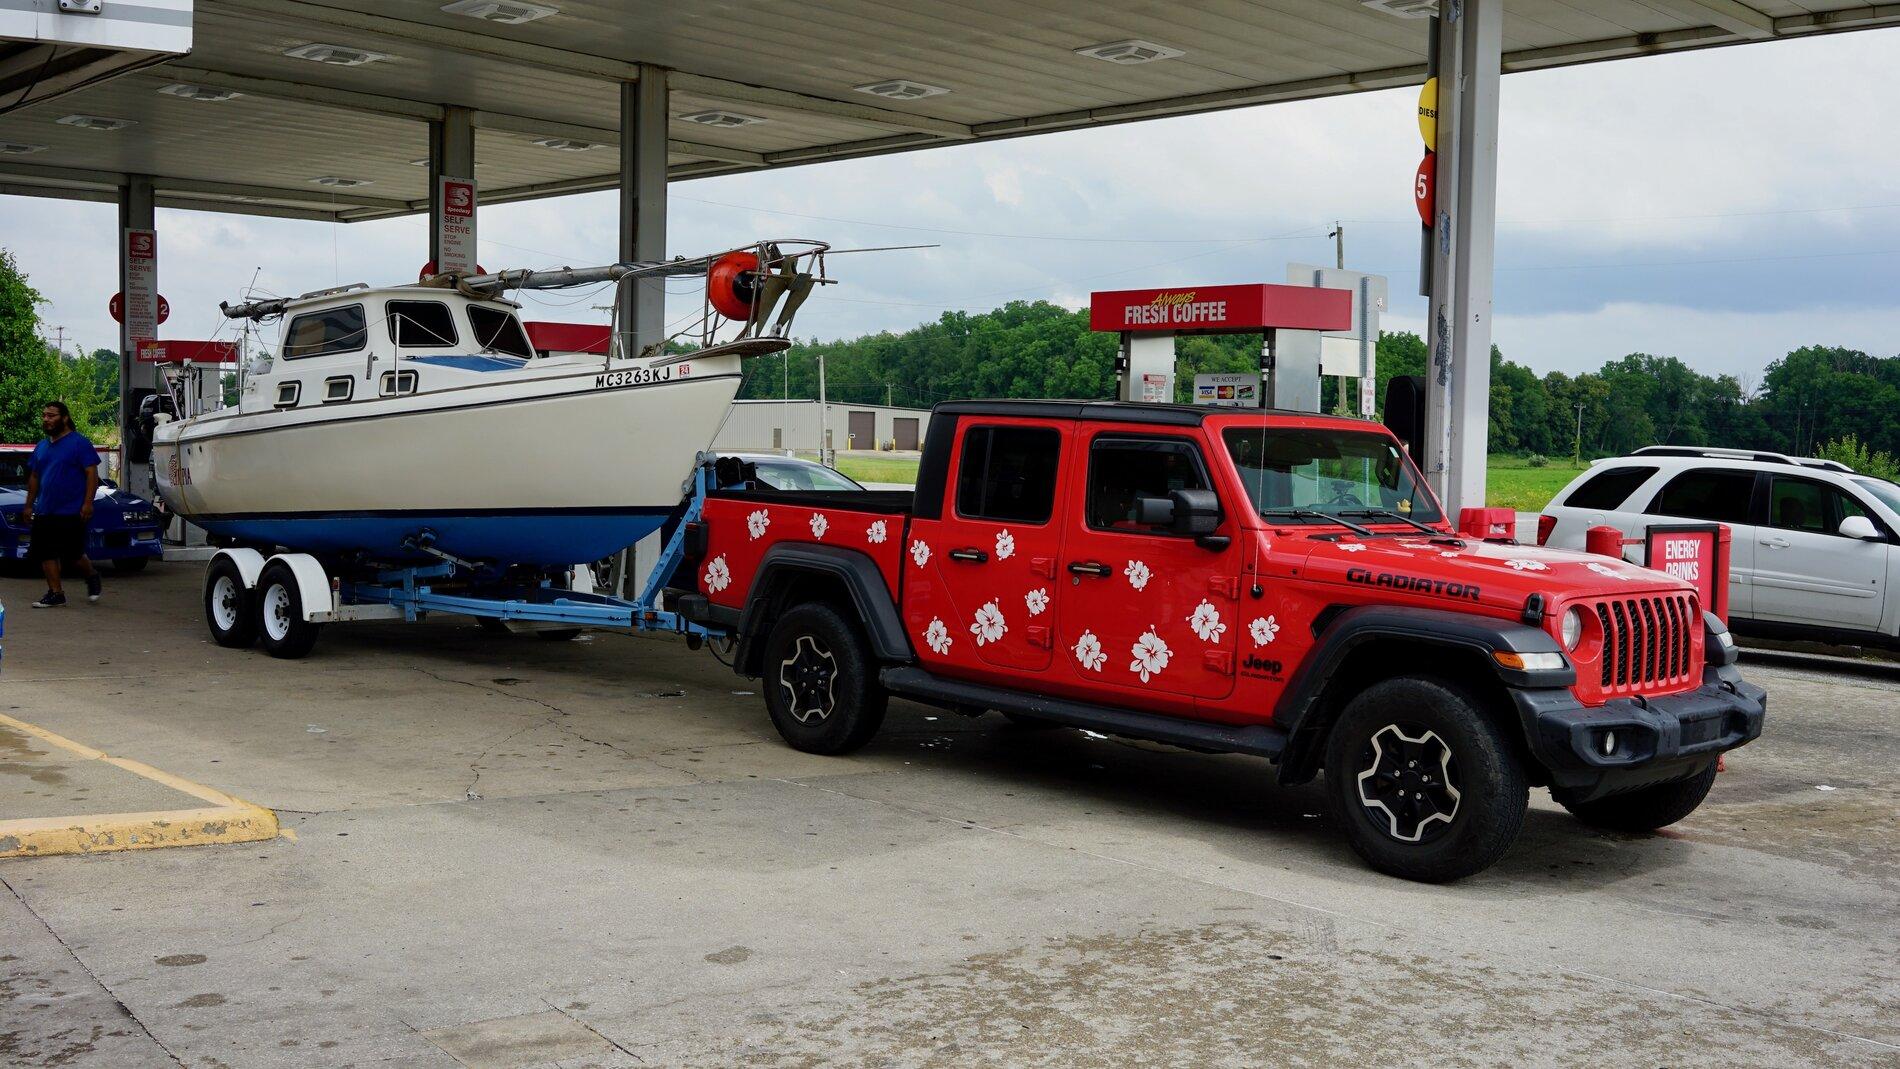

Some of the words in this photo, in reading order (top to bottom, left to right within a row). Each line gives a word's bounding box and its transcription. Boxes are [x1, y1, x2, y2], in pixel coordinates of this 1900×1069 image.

[1418, 106, 1439, 120] DIESE
[1416, 173, 1427, 200] 5
[447, 206, 471, 214] Speedway
[444, 215, 464, 225] SELF
[444, 225, 471, 235] SERVE
[129, 264, 152, 272] SERVE
[111, 302, 117, 313] 1
[160, 303, 168, 315] 2
[1149, 291, 1196, 309] Always
[1124, 305, 1169, 325] FRESH
[1173, 301, 1227, 323] COFFEE
[595, 366, 671, 388] MC3263KJ
[1665, 539, 1701, 559] ENERGY
[1665, 561, 1699, 580] DRINKS
[1346, 567, 1481, 601] GLADIATOR
[1242, 654, 1283, 675] Jeep
